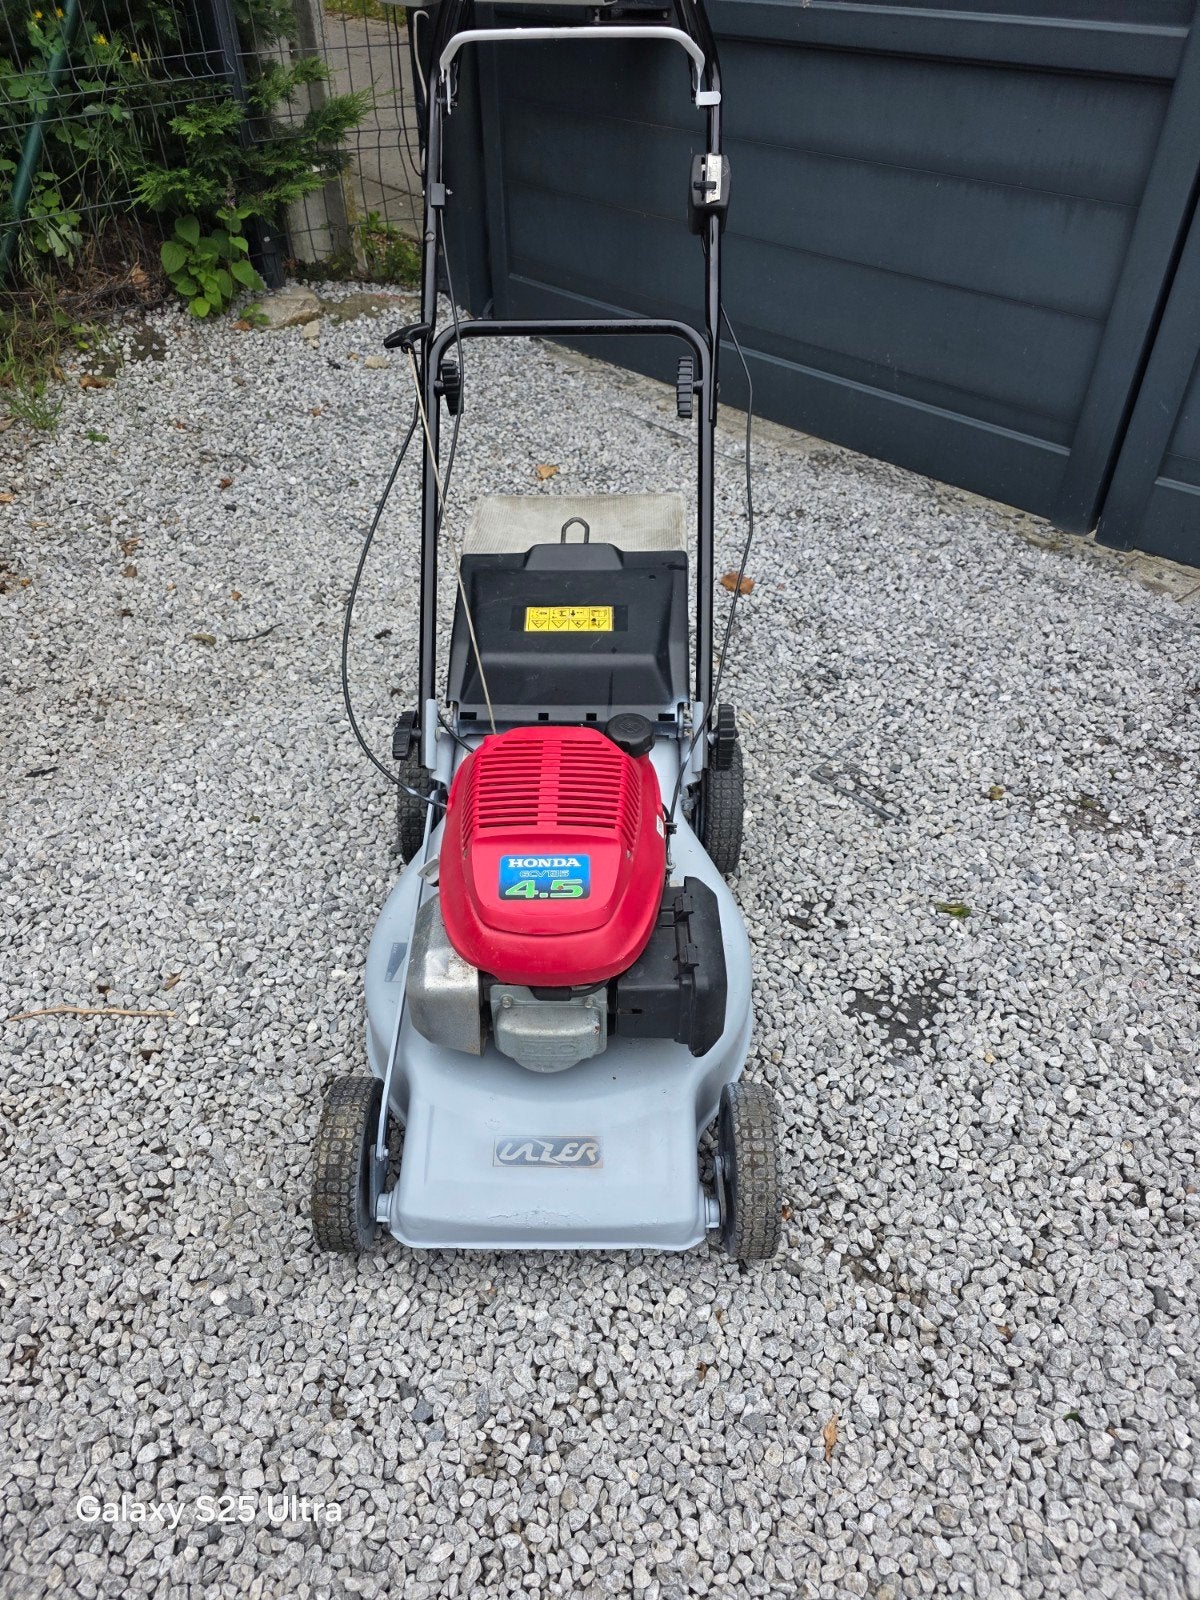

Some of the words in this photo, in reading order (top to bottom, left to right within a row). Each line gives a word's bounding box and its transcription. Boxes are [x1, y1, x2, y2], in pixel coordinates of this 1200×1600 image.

[508, 858, 581, 868] HONDA
[505, 879, 583, 899] 4.5
[499, 1139, 600, 1165] LAZER
